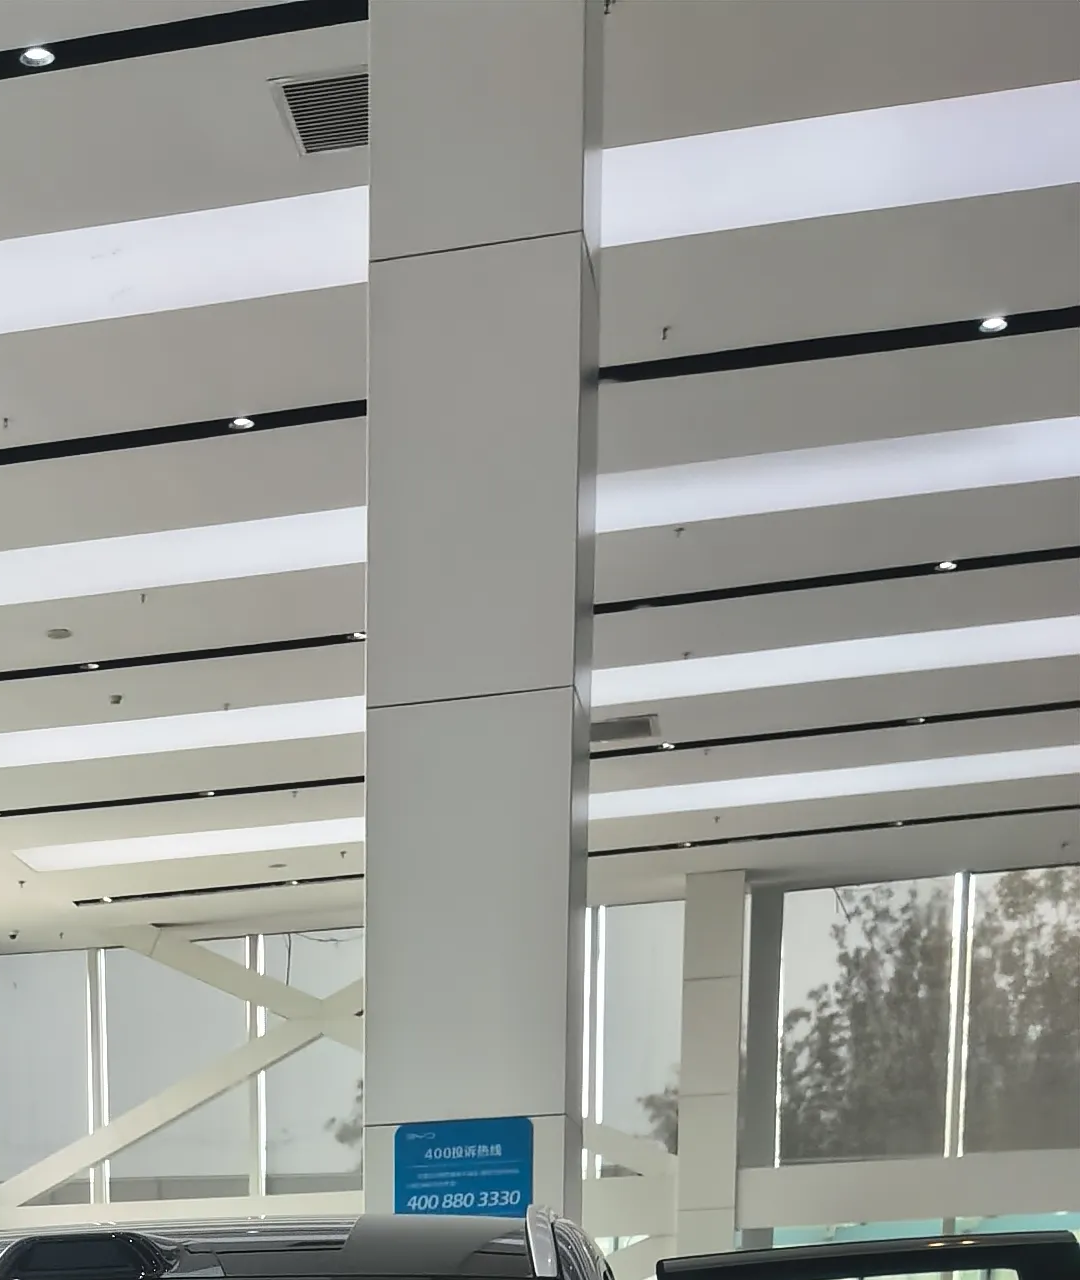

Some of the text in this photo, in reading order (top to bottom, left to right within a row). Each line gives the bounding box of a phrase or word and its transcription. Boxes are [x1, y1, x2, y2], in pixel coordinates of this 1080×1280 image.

[406, 1190, 521, 1210] 400 880 3330
